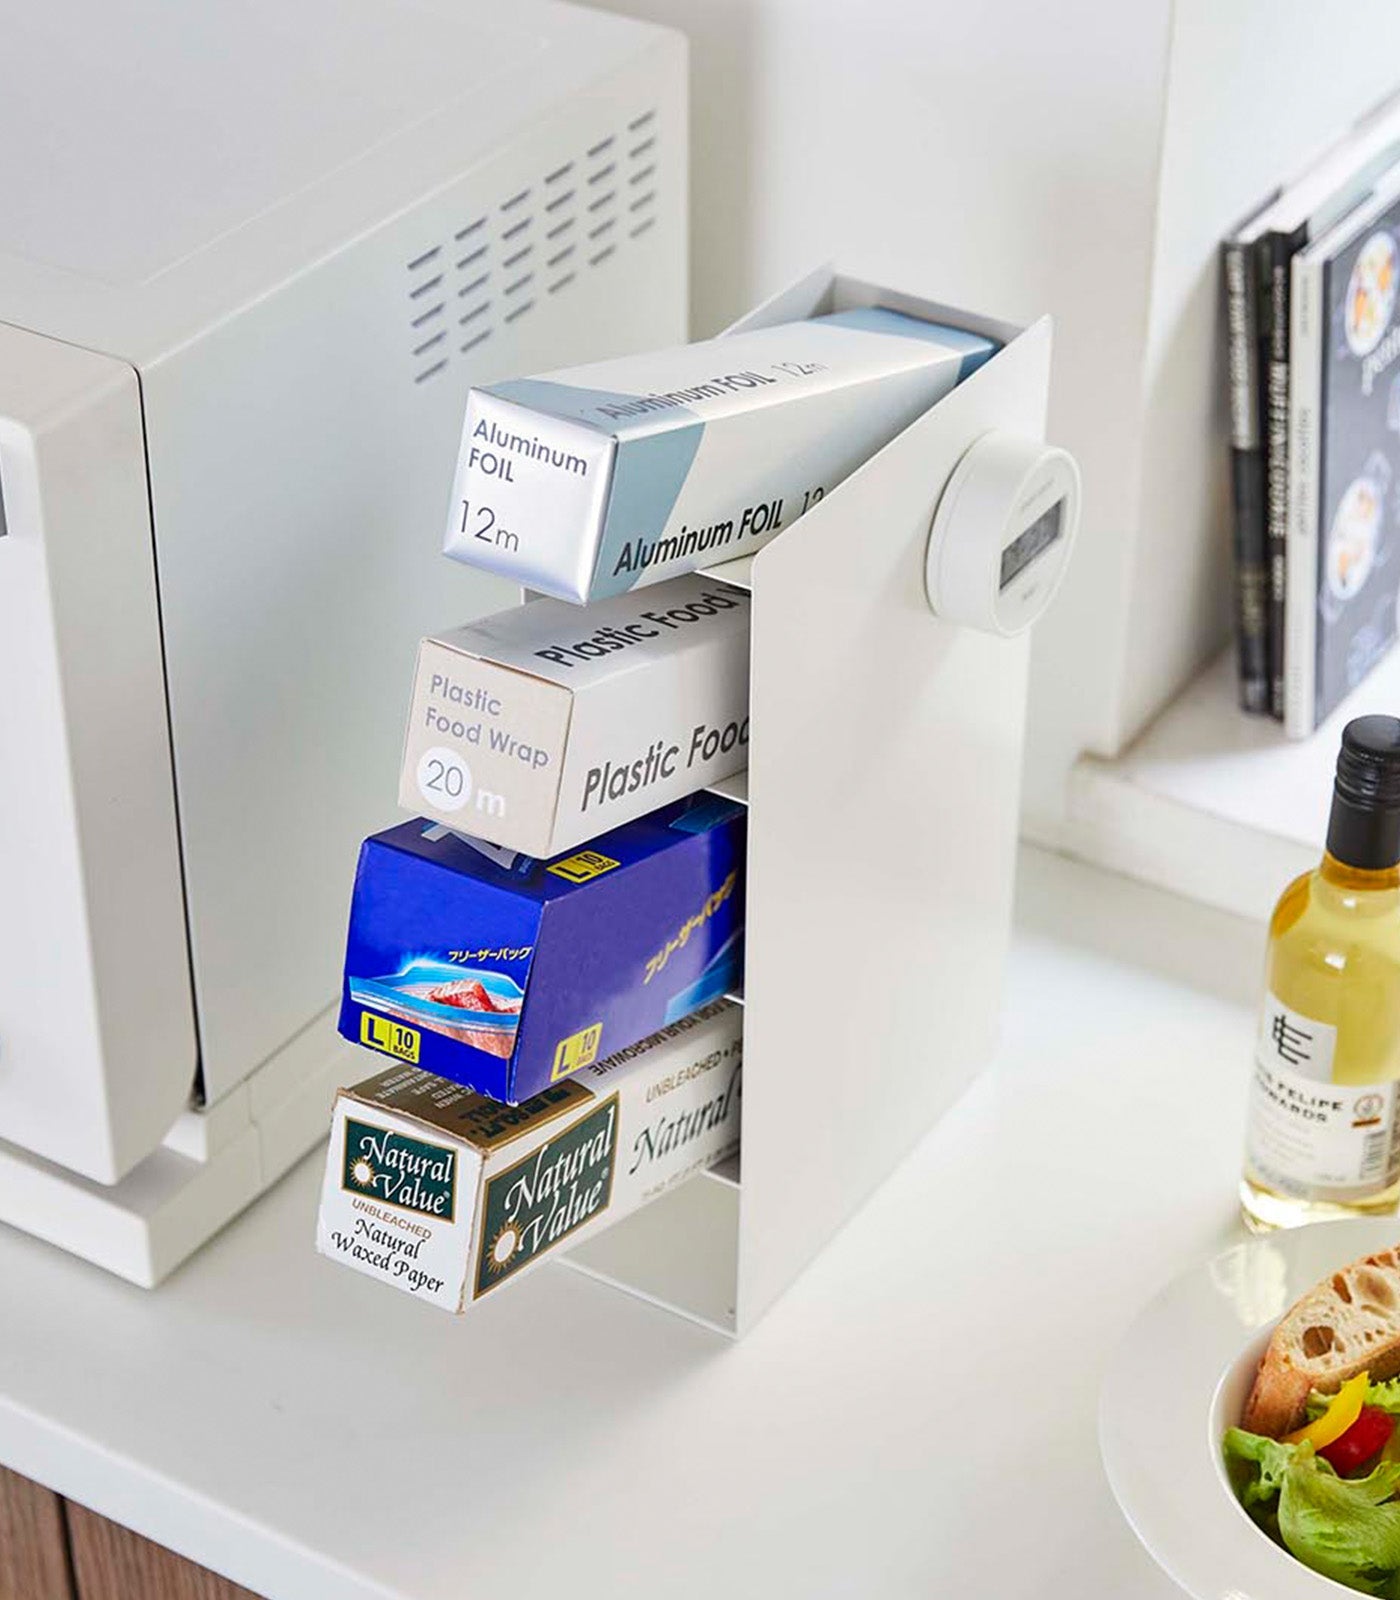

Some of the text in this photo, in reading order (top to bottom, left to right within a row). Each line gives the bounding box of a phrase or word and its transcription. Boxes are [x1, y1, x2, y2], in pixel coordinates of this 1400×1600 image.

[597, 383, 727, 420] Aluminum
[713, 371, 776, 391] FOIL
[469, 447, 514, 482] FOIL
[473, 419, 587, 476] Aluminum
[461, 500, 519, 552] 12m
[613, 519, 733, 576] Aluminum
[737, 499, 784, 539] FOIL
[534, 592, 739, 667] Plastic Food
[430, 674, 502, 716] Plastic
[425, 706, 549, 770] Food Wrap
[426, 759, 464, 797] 20
[581, 740, 679, 812] Plastic
[555, 854, 603, 879] L 10
[448, 946, 533, 963] フリーザーバッグ
[368, 1017, 414, 1049] L 10
[393, 1045, 415, 1060] BAGS
[588, 1030, 667, 1076] MICROWAVE
[557, 1044, 570, 1075] L
[646, 1050, 722, 1102] UNBLEACHED
[629, 1063, 742, 1175] Natural
[360, 1131, 453, 1183] Natural
[504, 1105, 615, 1223] Natural
[351, 1198, 432, 1239] UNBLEACHED
[355, 1218, 425, 1259] Natural
[331, 1231, 444, 1293] Waxed Paper
